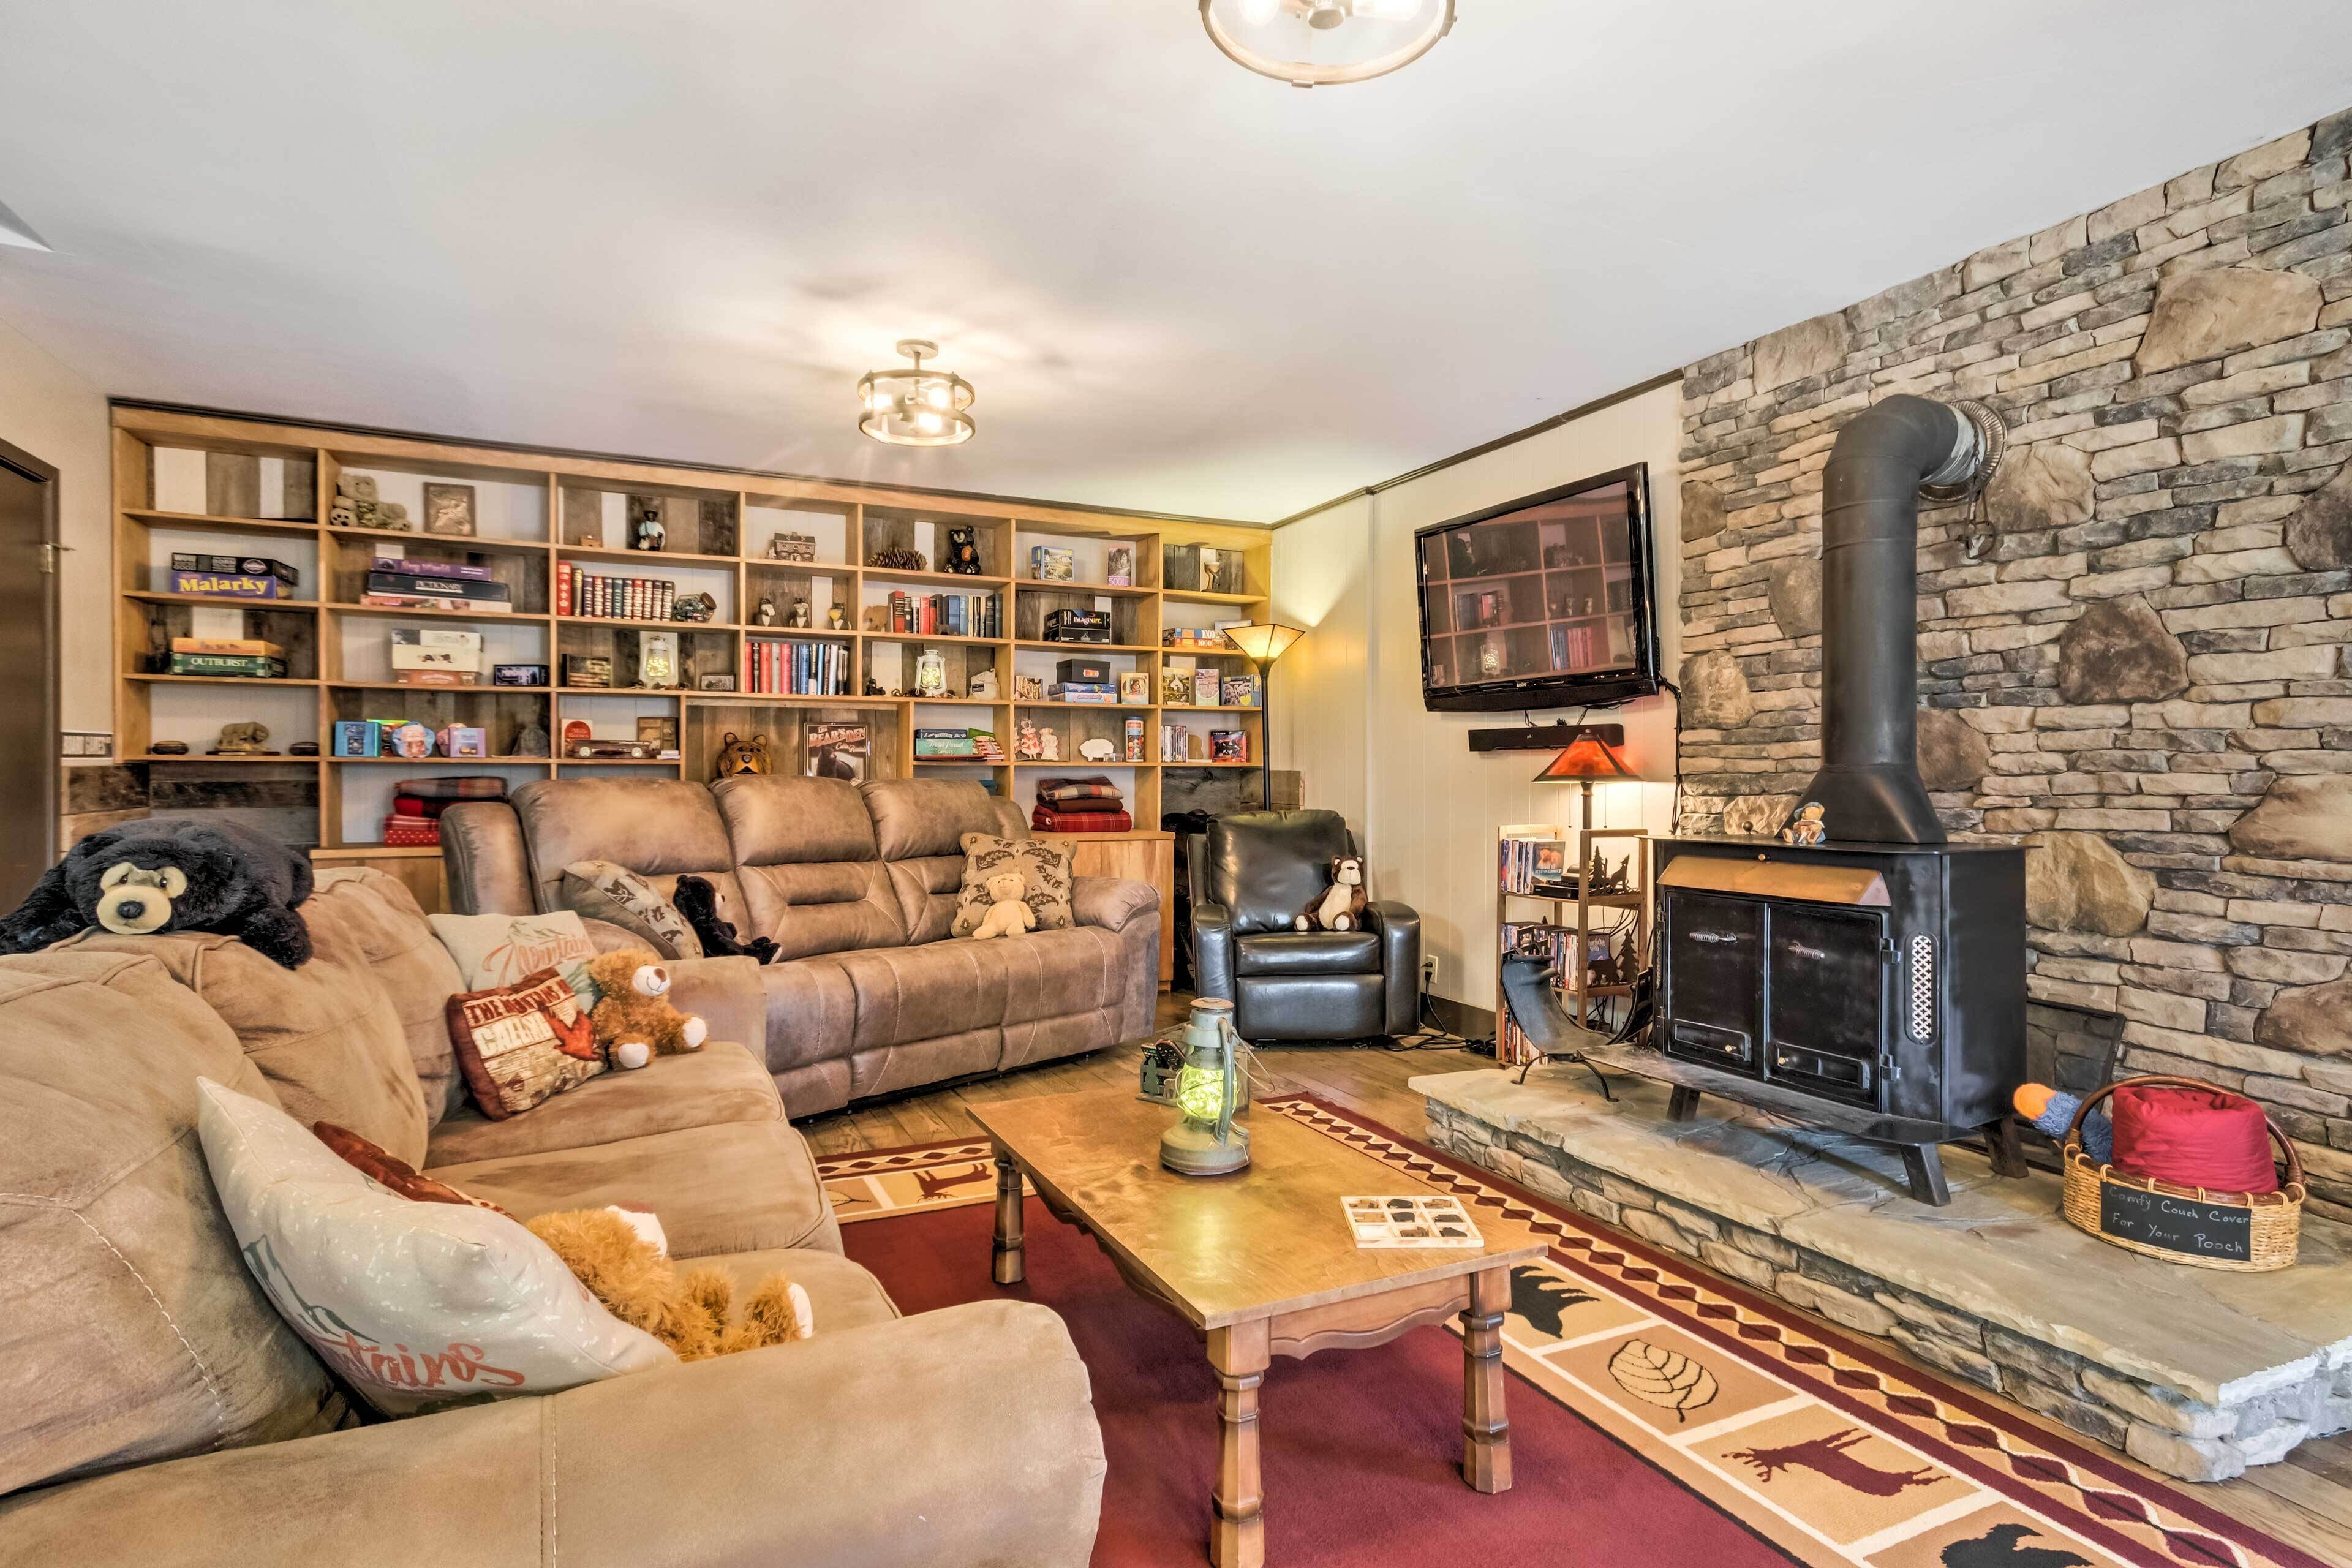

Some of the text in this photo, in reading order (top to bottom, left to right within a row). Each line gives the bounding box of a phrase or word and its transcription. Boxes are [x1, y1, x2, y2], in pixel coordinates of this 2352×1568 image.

[179, 577, 268, 594] Malarky
[190, 657, 248, 667] OUTBURST
[466, 1000, 503, 1024] THE
[2108, 1186, 2249, 1224] Comfy Couch Cover
[2112, 1213, 2244, 1254] For Your Pooch
